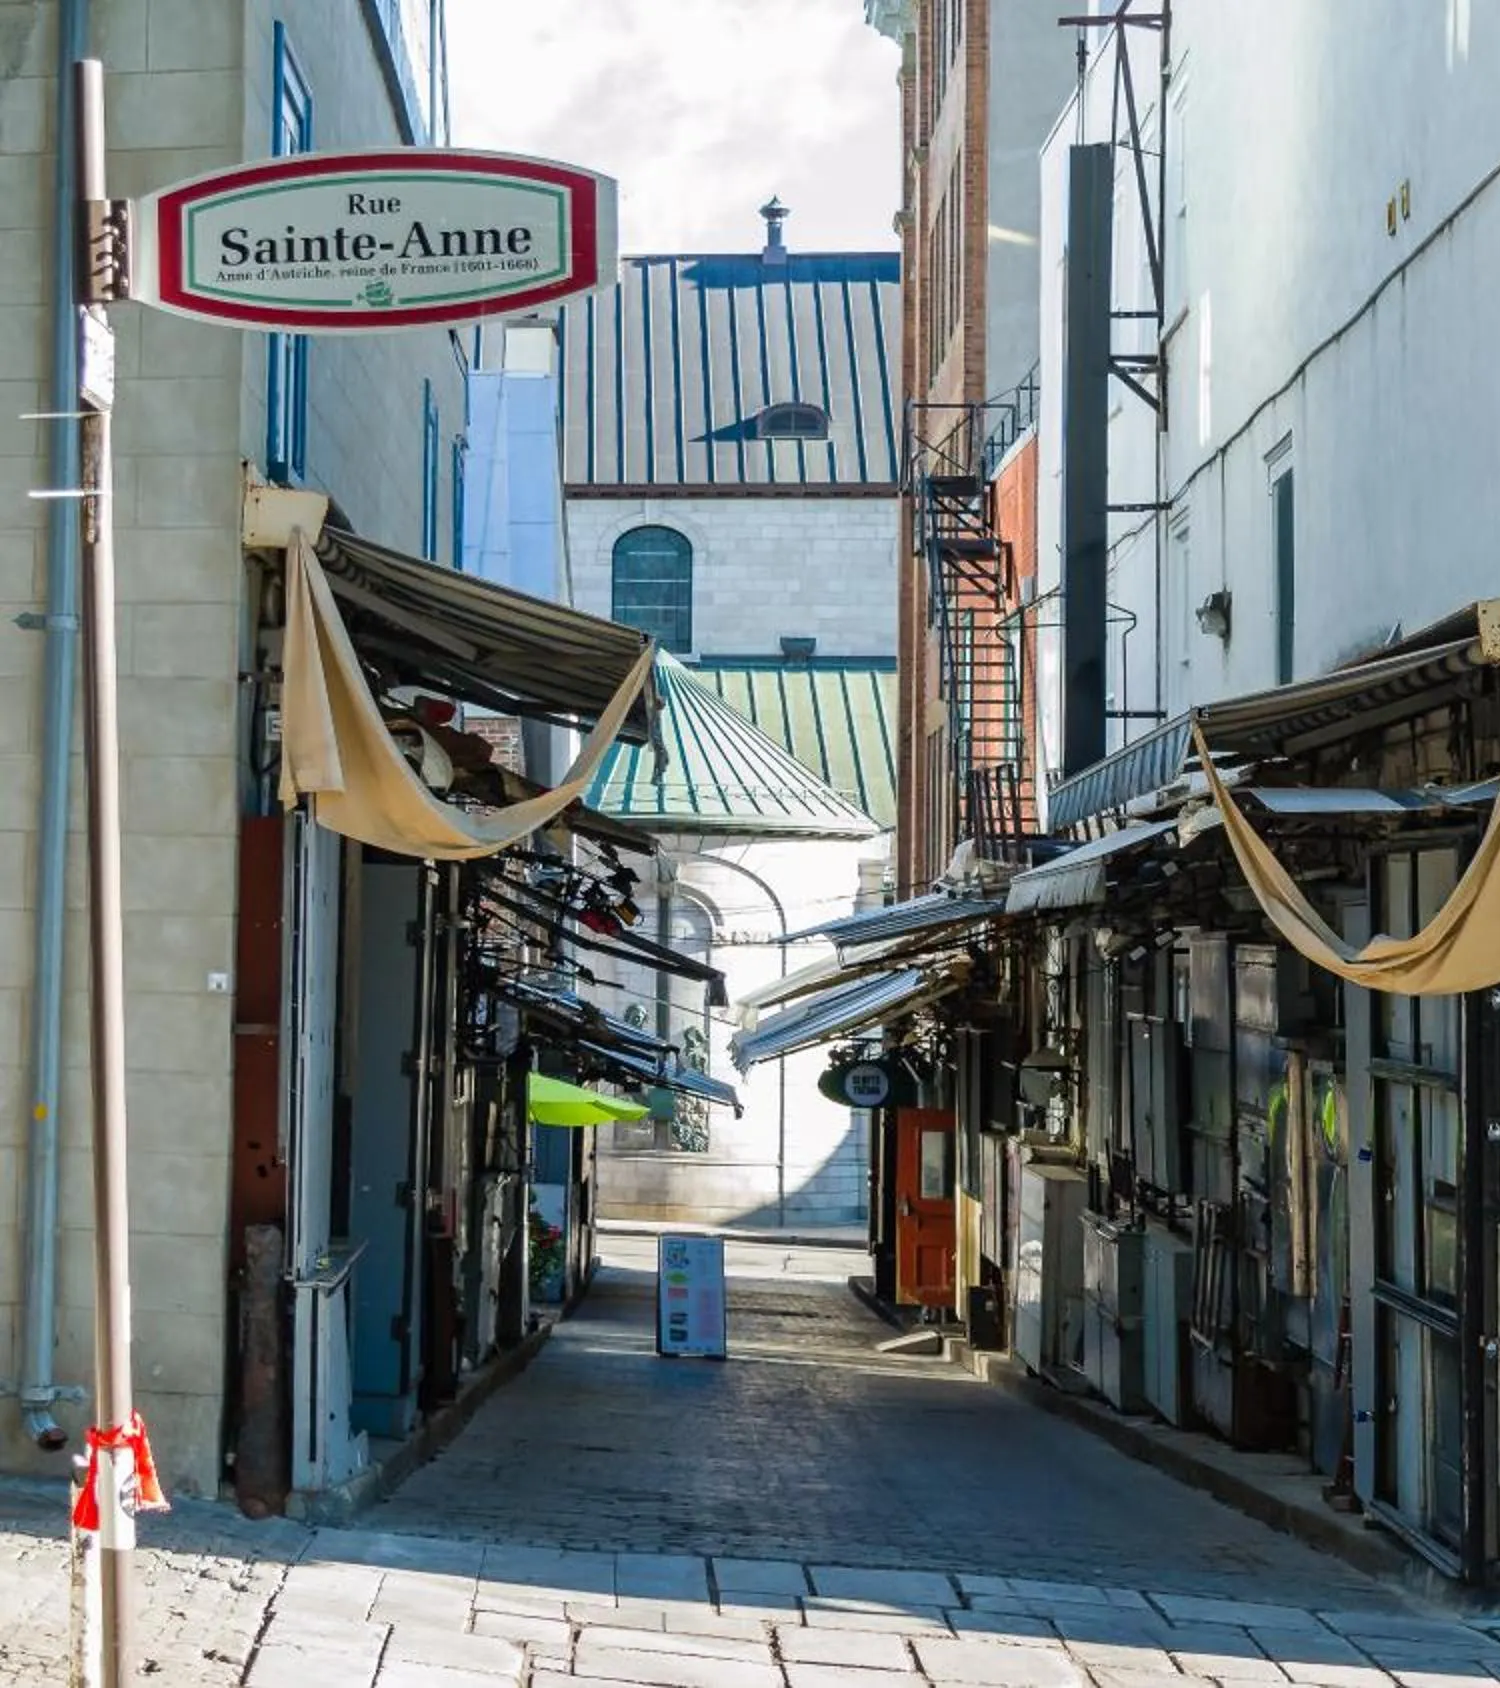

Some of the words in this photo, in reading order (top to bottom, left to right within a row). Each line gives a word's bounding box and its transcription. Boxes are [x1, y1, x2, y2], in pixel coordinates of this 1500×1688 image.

[348, 193, 401, 216] Rue
[220, 221, 532, 267] Sainte-Anne
[216, 271, 251, 282] Anne
[340, 266, 376, 277] reine
[379, 264, 397, 276] de
[400, 262, 451, 275] France
